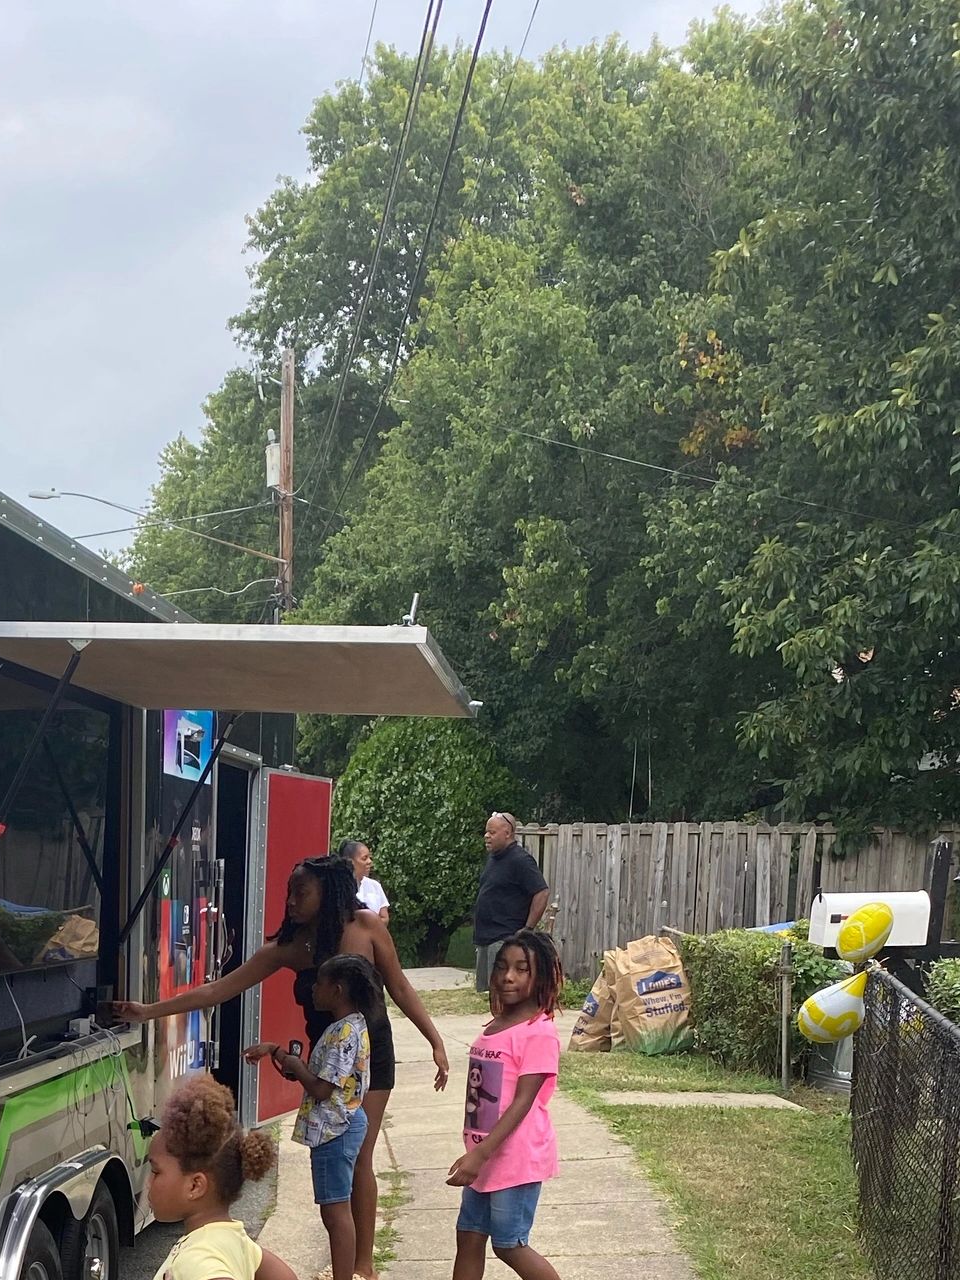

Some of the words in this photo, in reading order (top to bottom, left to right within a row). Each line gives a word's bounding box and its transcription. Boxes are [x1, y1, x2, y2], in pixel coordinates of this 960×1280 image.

[643, 996, 670, 1006] Whew,
[670, 993, 683, 1001] I'm
[646, 1001, 689, 1018] Stuffed.
